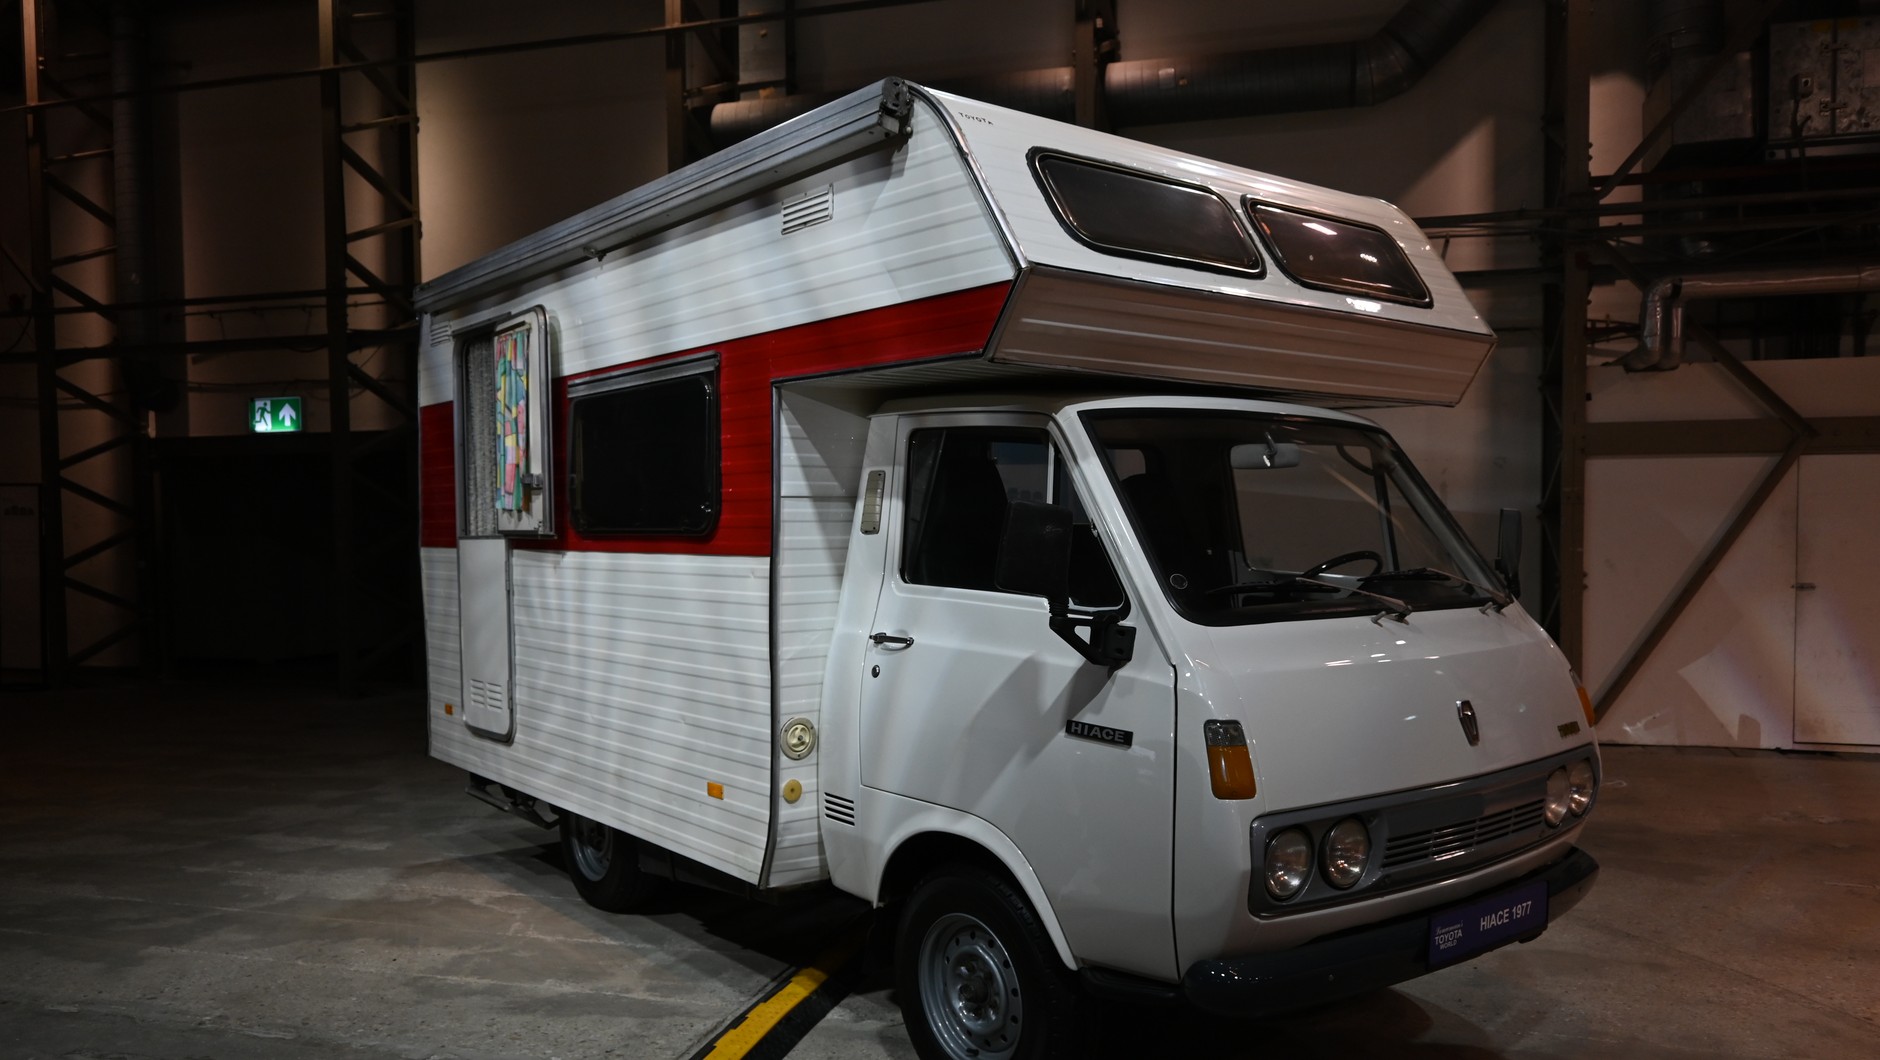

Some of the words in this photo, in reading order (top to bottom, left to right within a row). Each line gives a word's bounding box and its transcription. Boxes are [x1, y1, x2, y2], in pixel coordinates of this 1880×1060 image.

[958, 112, 994, 125] TOYOTA
[1070, 721, 1125, 743] HIACE
[1480, 908, 1510, 931] HIACE
[1512, 901, 1532, 920] 1977
[1435, 929, 1463, 945] TOYOTA
[1440, 939, 1457, 950] WORLD
